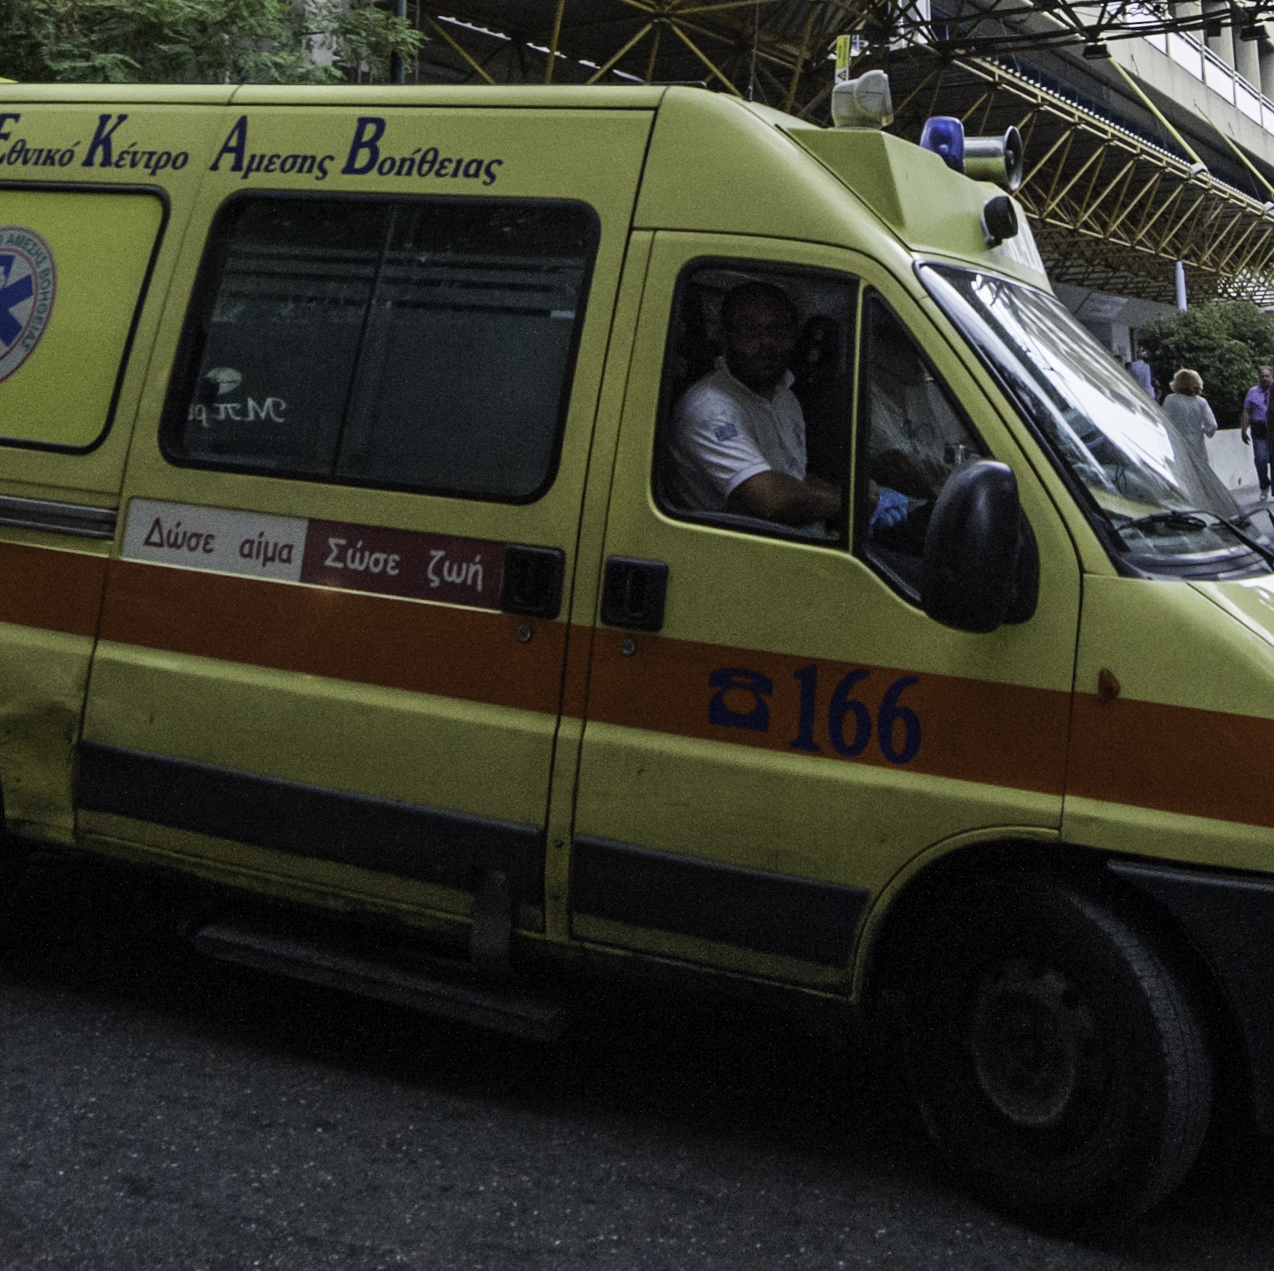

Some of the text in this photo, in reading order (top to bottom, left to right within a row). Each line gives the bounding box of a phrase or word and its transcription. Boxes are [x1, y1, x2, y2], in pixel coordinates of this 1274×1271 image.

[81, 113, 190, 177] Κέντρο
[209, 115, 336, 181] Αμεσης
[340, 116, 504, 187] Βοήθειας
[143, 516, 295, 568] Δώσε αίμα
[323, 536, 484, 592] Σώσε ζωή
[788, 662, 923, 766] 166
